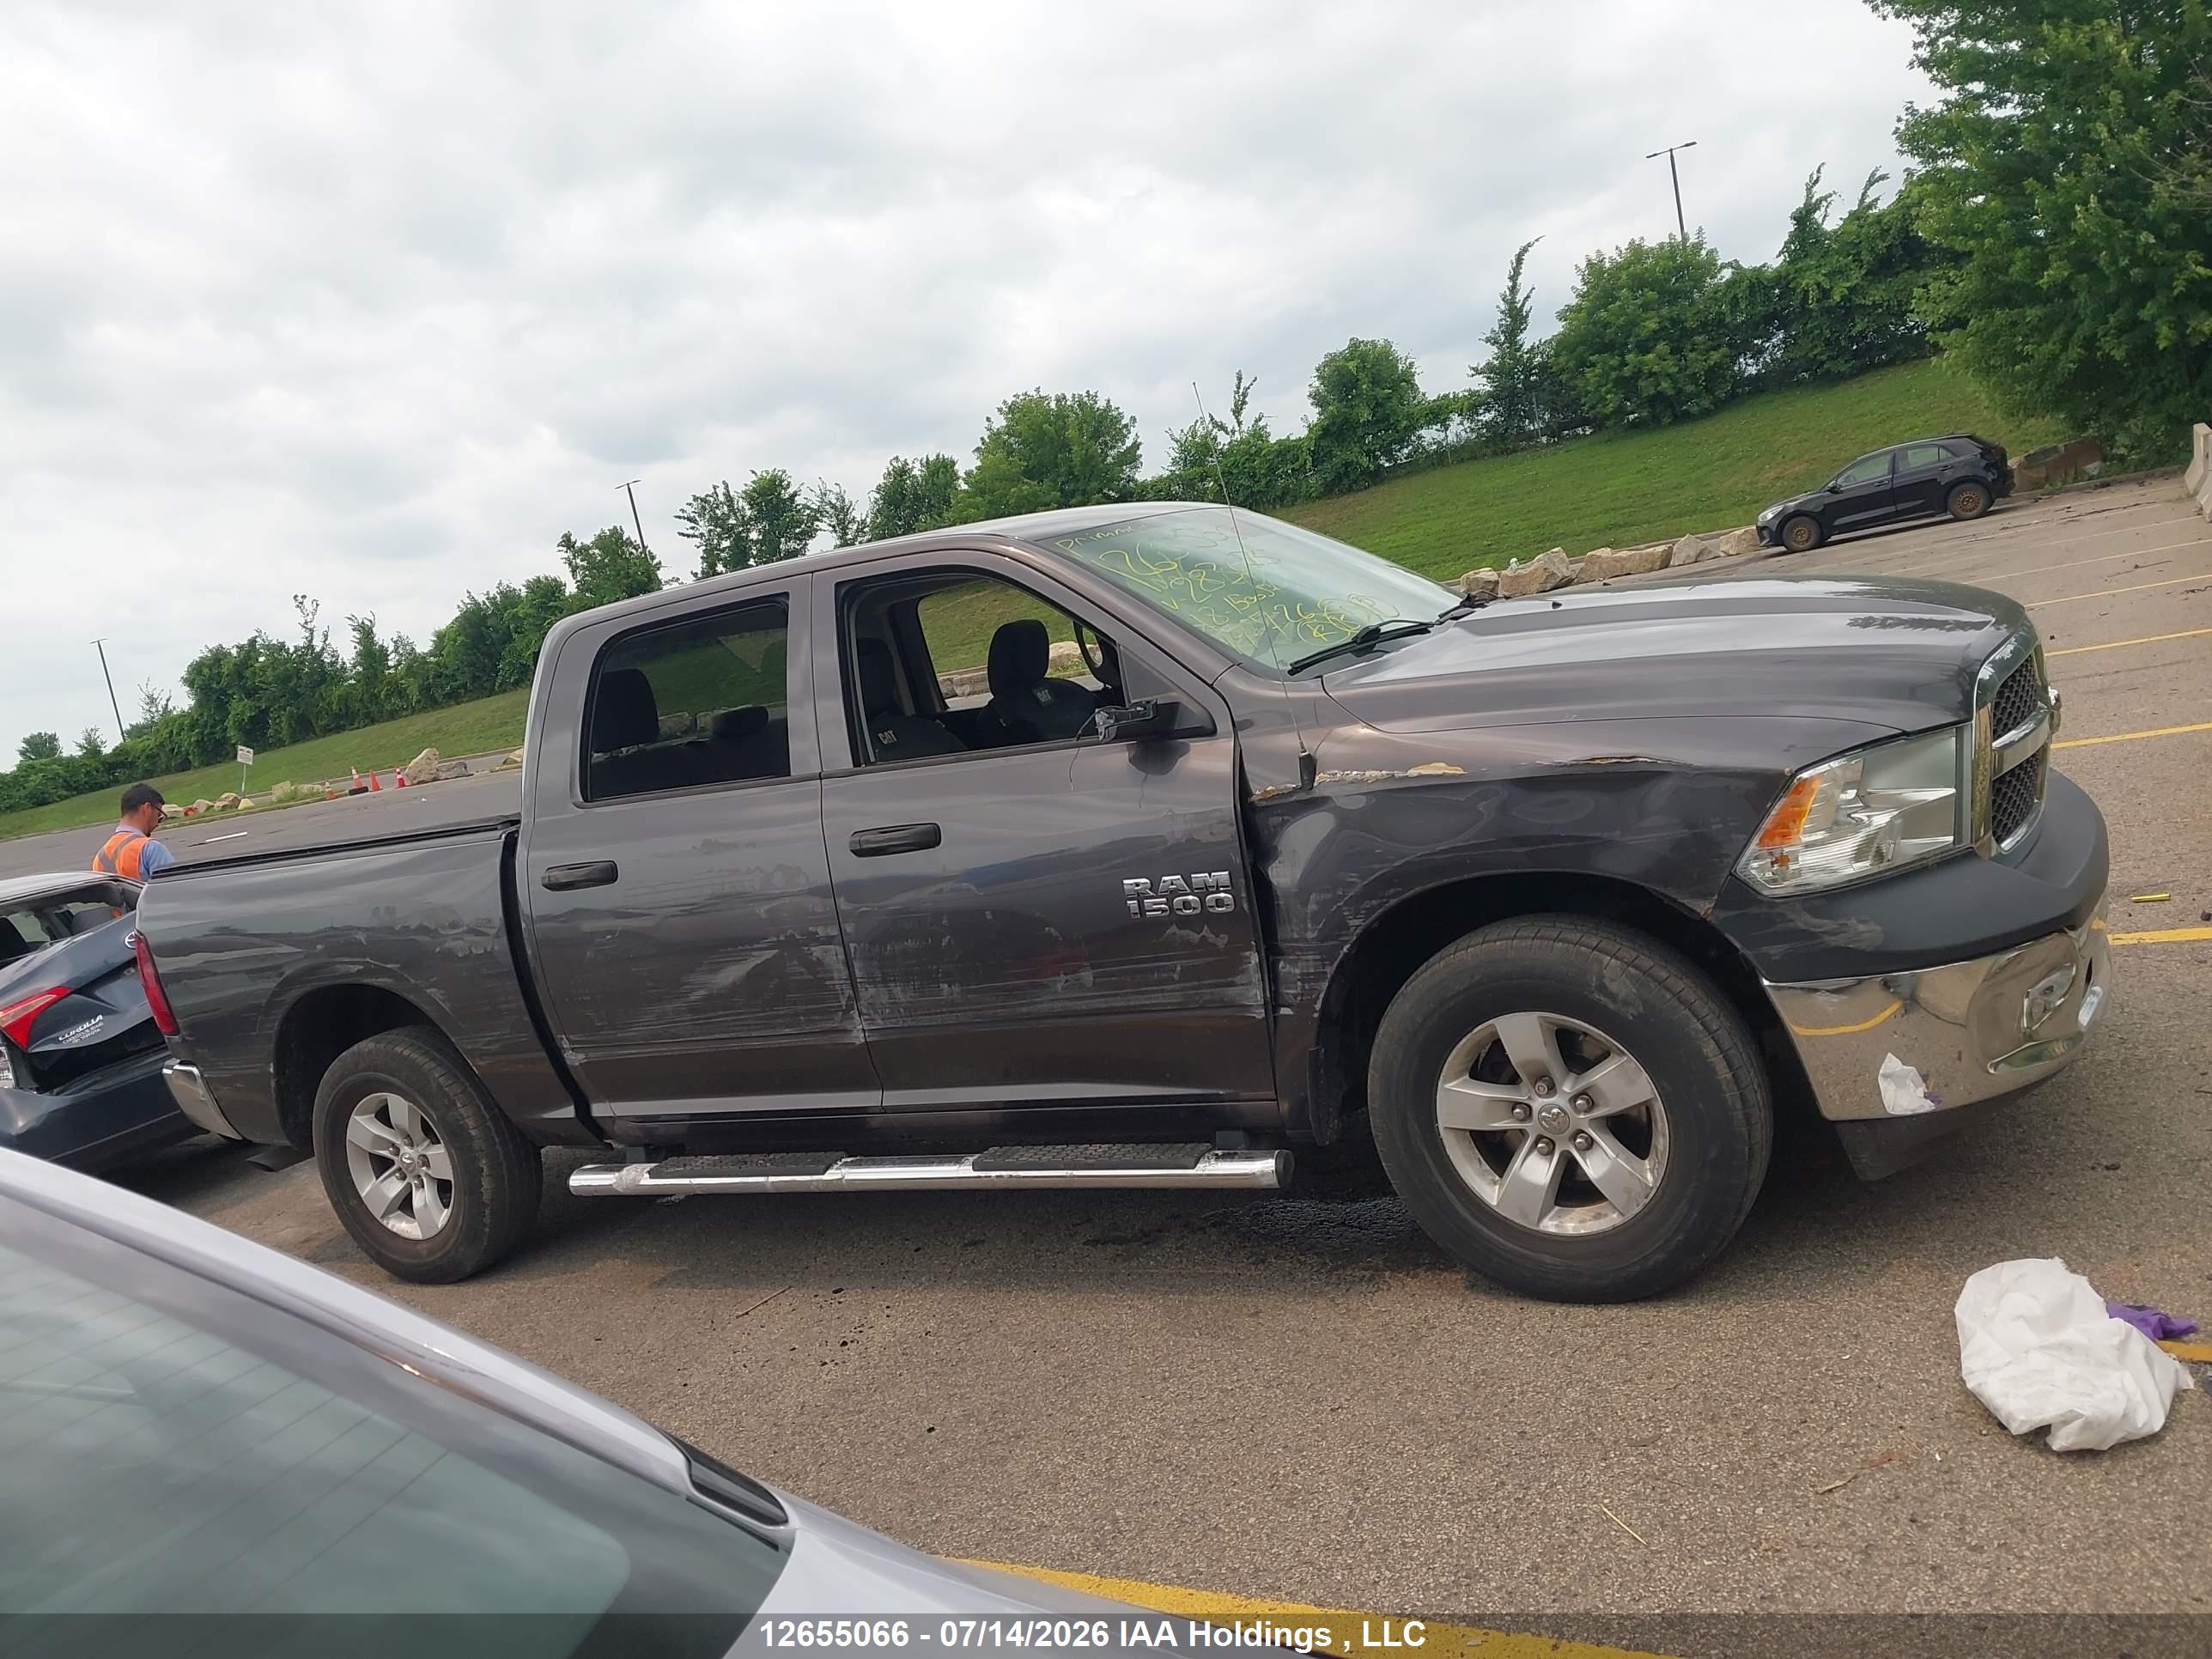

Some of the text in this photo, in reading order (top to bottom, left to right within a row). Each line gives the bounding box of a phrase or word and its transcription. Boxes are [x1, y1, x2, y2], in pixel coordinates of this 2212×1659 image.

[878, 730, 897, 744] CAT
[1122, 871, 1233, 898] RAM
[1126, 892, 1235, 920] 1500
